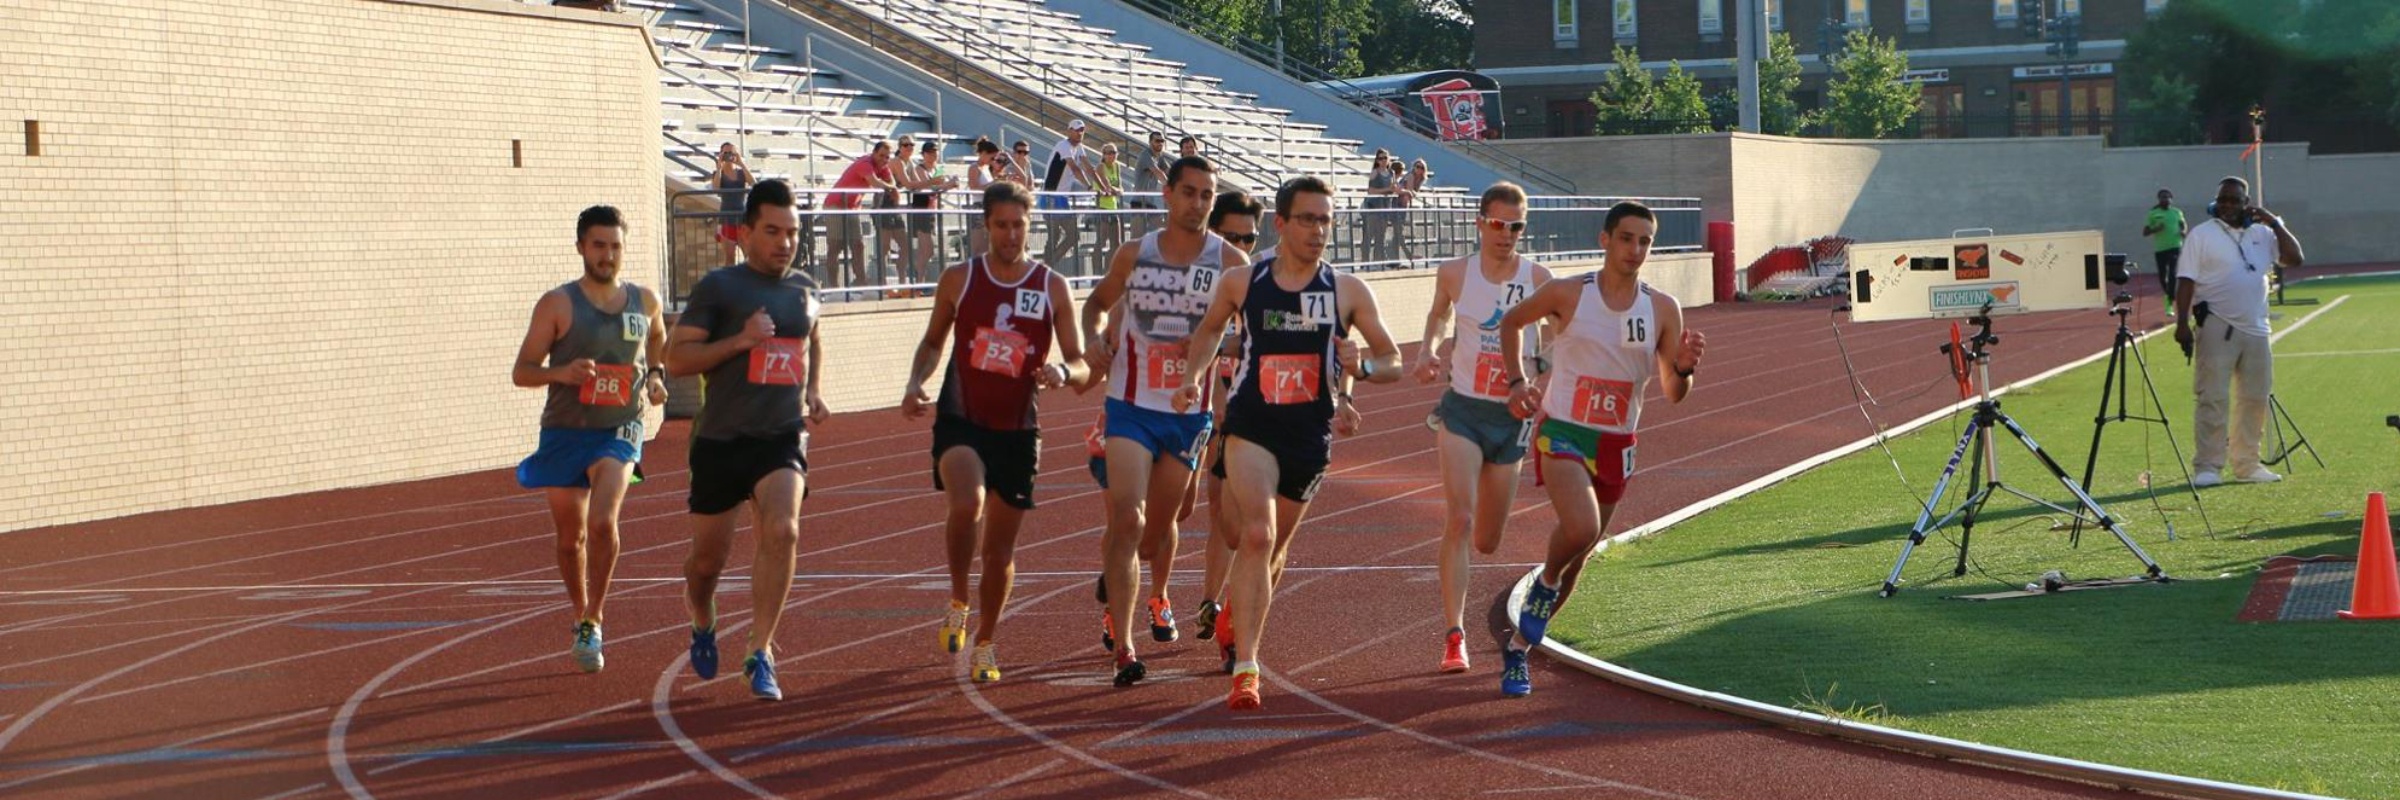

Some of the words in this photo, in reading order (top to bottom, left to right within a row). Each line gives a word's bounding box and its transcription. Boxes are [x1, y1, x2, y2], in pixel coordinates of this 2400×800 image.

[1193, 268, 1213, 293] 69
[1020, 291, 1039, 314] 52
[1506, 284, 1524, 305] 73
[1936, 290, 1988, 307] FINISHLYNX
[1308, 294, 1328, 318] 71
[629, 315, 643, 337] 66
[1627, 318, 1645, 342] 16
[766, 353, 790, 370] 77
[987, 342, 1013, 361] 52
[1163, 359, 1187, 375] 69
[596, 378, 619, 393] 66
[1278, 371, 1303, 389] 71
[1591, 393, 1616, 411] 16
[1948, 435, 1970, 470] LYNX
